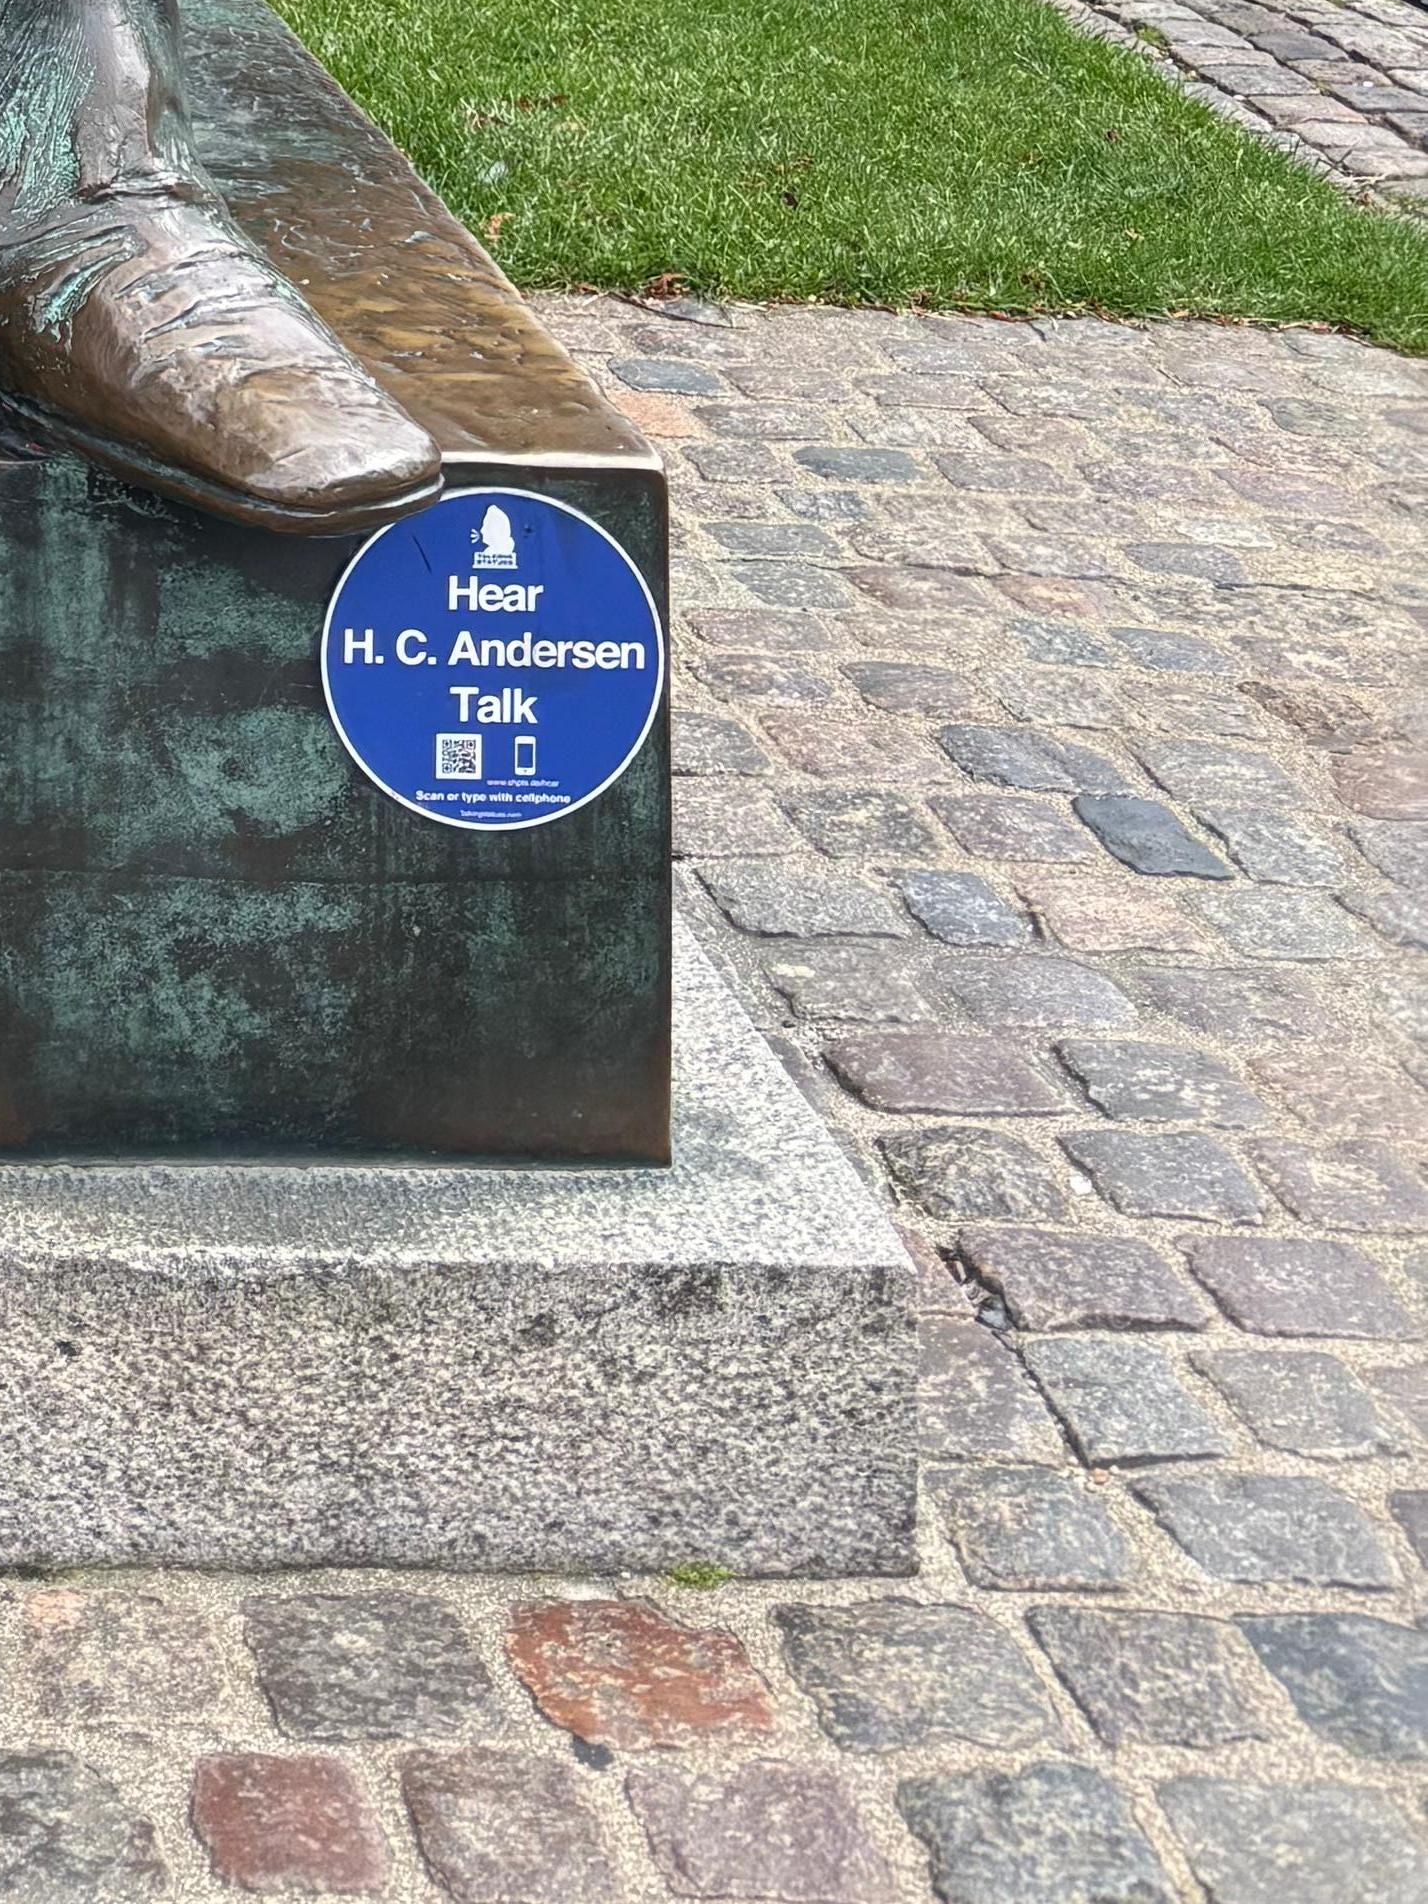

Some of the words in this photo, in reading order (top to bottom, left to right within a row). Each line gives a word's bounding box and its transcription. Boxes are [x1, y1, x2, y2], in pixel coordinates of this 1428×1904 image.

[448, 575, 544, 612] Hear
[344, 628, 384, 665] H.
[395, 629, 437, 666] C.
[448, 630, 645, 669] Andersen
[449, 686, 538, 724] Talk
[415, 790, 444, 801] Scan
[447, 793, 458, 801] or
[462, 792, 486, 803] type
[489, 792, 513, 802] with
[515, 792, 572, 804] cellphone
